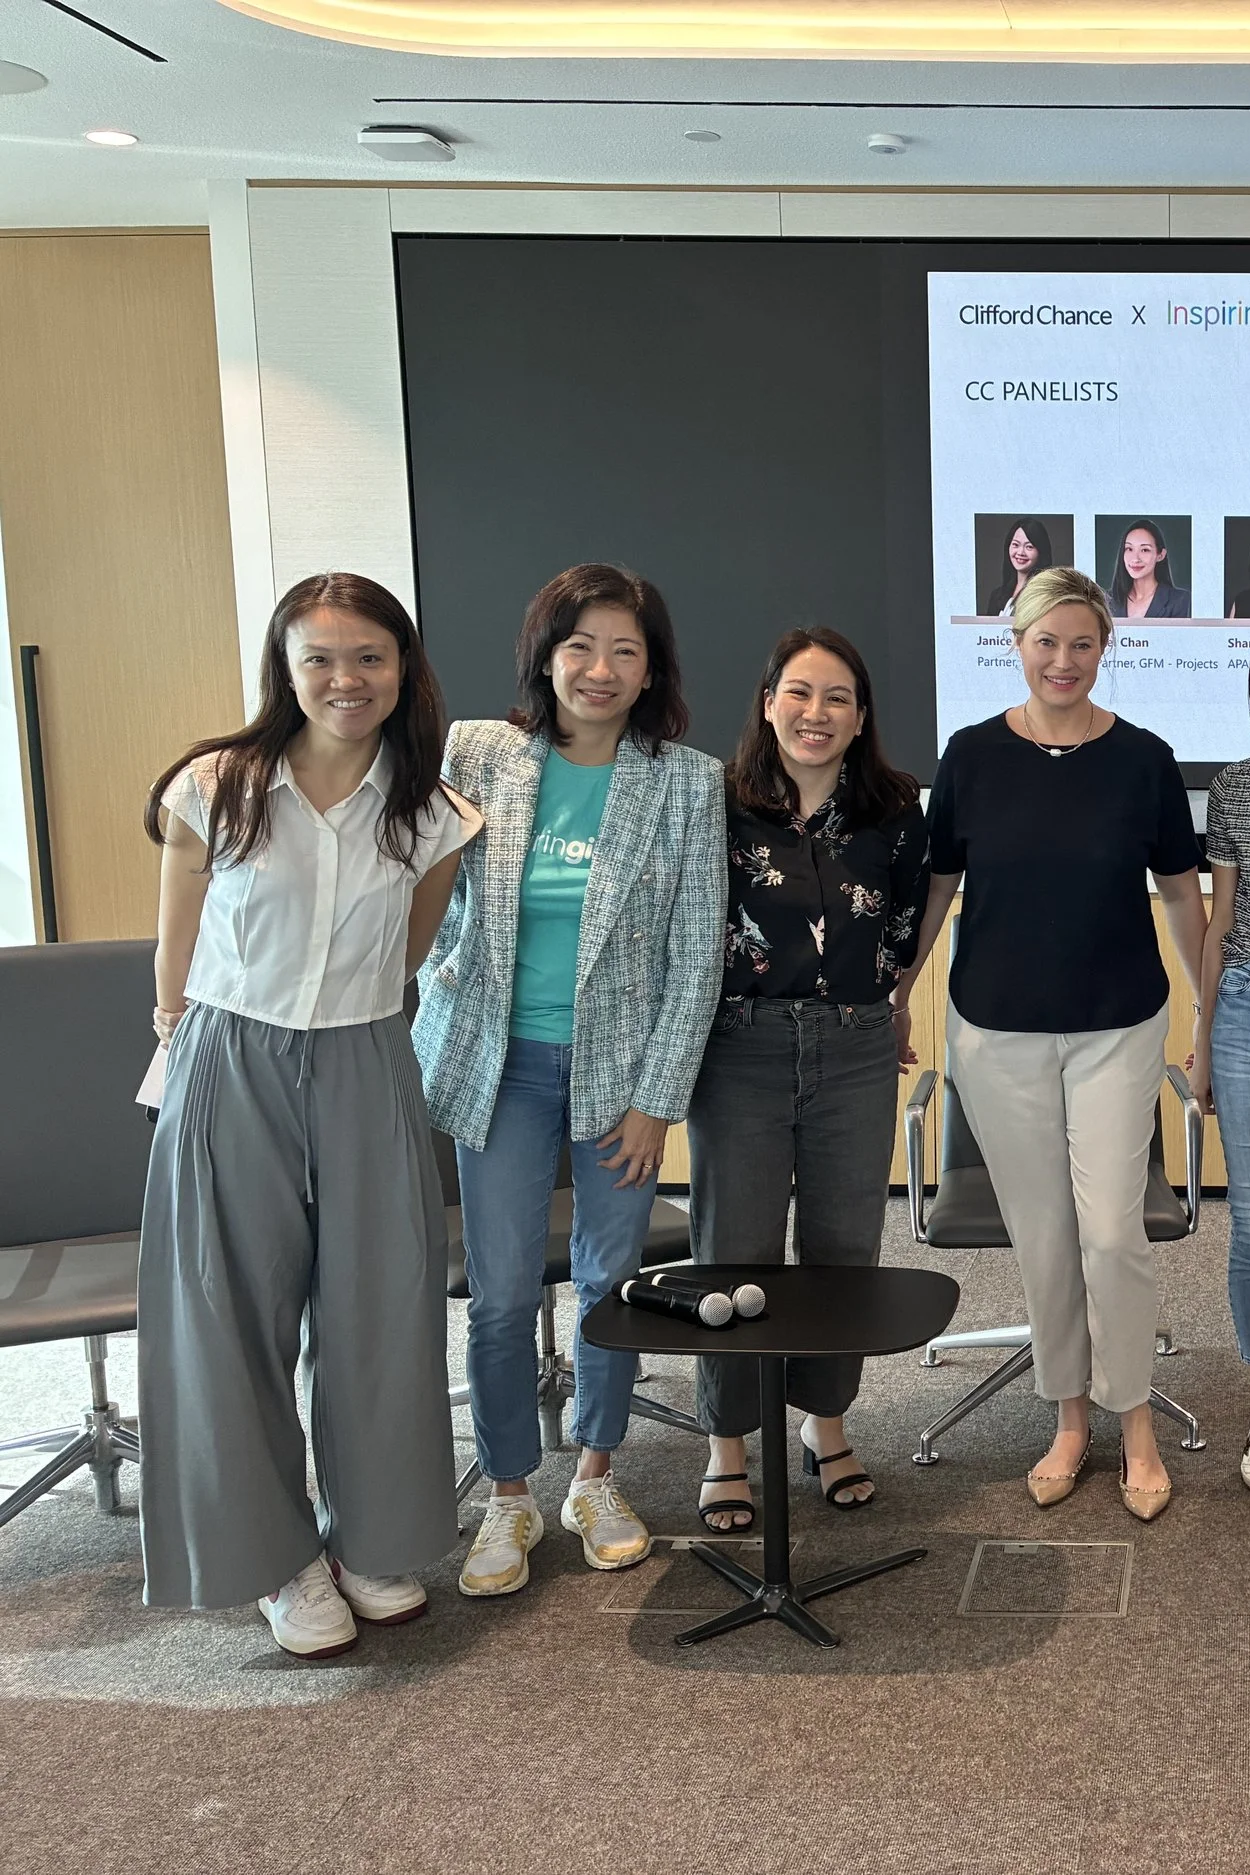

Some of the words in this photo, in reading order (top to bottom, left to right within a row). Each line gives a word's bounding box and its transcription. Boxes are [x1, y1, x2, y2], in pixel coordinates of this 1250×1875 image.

[959, 304, 1034, 325] Clifford
[1036, 304, 1113, 325] Chance
[1131, 305, 1147, 325] X
[965, 381, 995, 401] CC
[1003, 381, 1119, 401] PANELISTS
[976, 636, 1012, 646] Janice
[1120, 637, 1149, 648] Chan
[977, 657, 1019, 669] Partner,
[1100, 658, 1136, 669] artner,
[1139, 658, 1165, 669] GFM
[1176, 658, 1219, 671] Projects
[1227, 659, 1249, 669] APA
[532, 830, 595, 864] ringi
